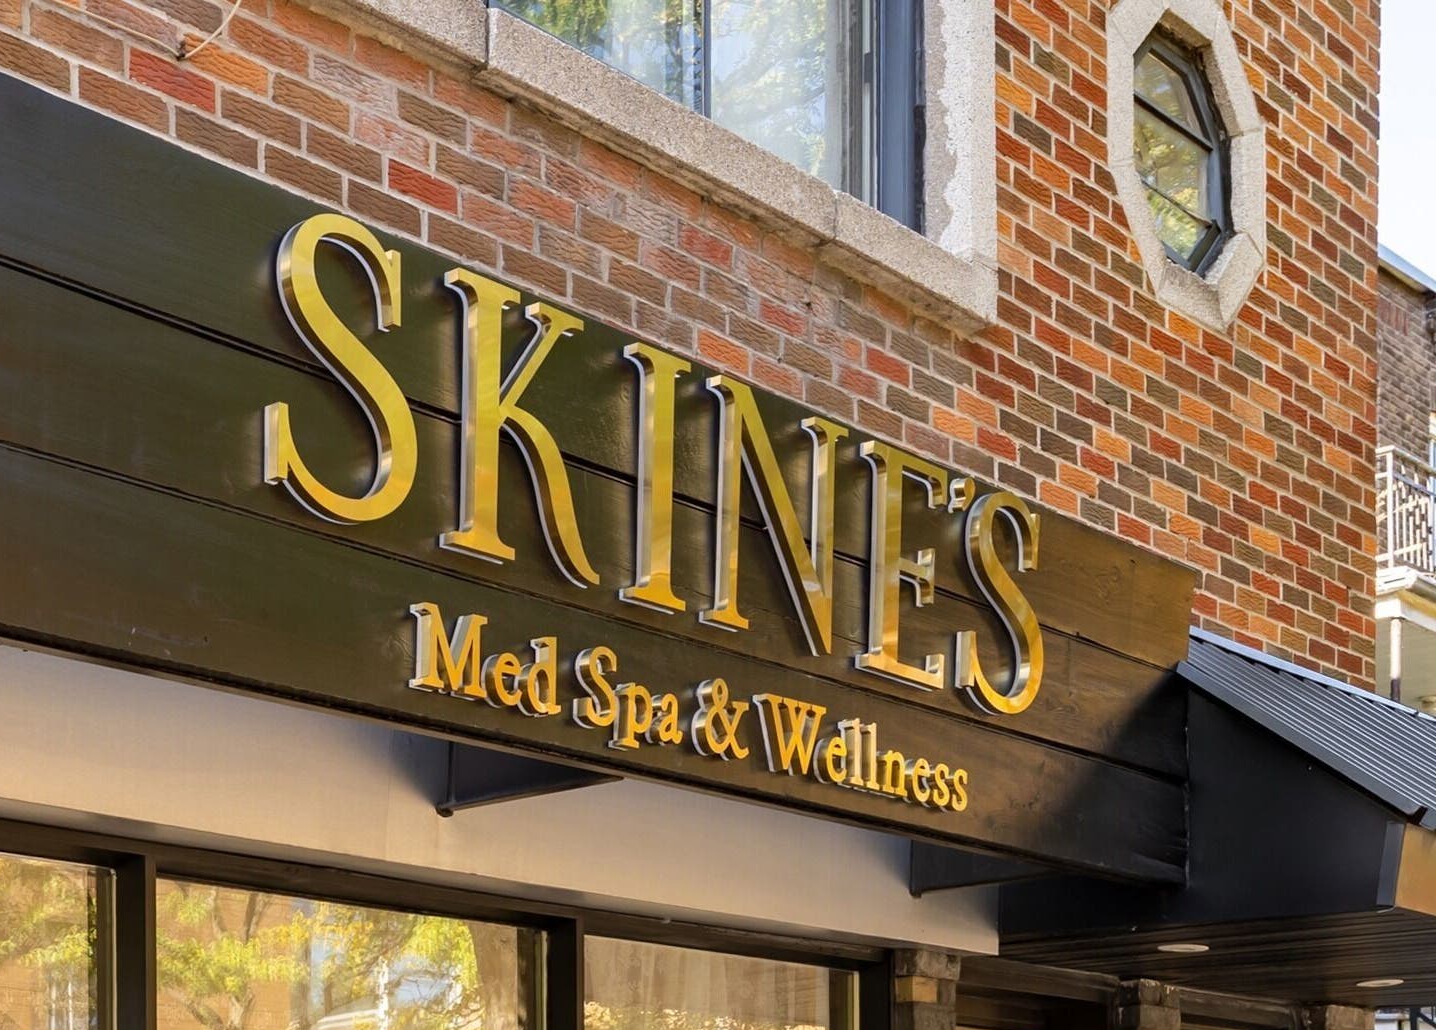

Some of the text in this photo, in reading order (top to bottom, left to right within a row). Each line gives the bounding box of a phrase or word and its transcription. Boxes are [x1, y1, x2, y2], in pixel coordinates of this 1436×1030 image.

[263, 213, 1045, 716] SKINE'S
[408, 601, 968, 812] Med Spa & Wellness
